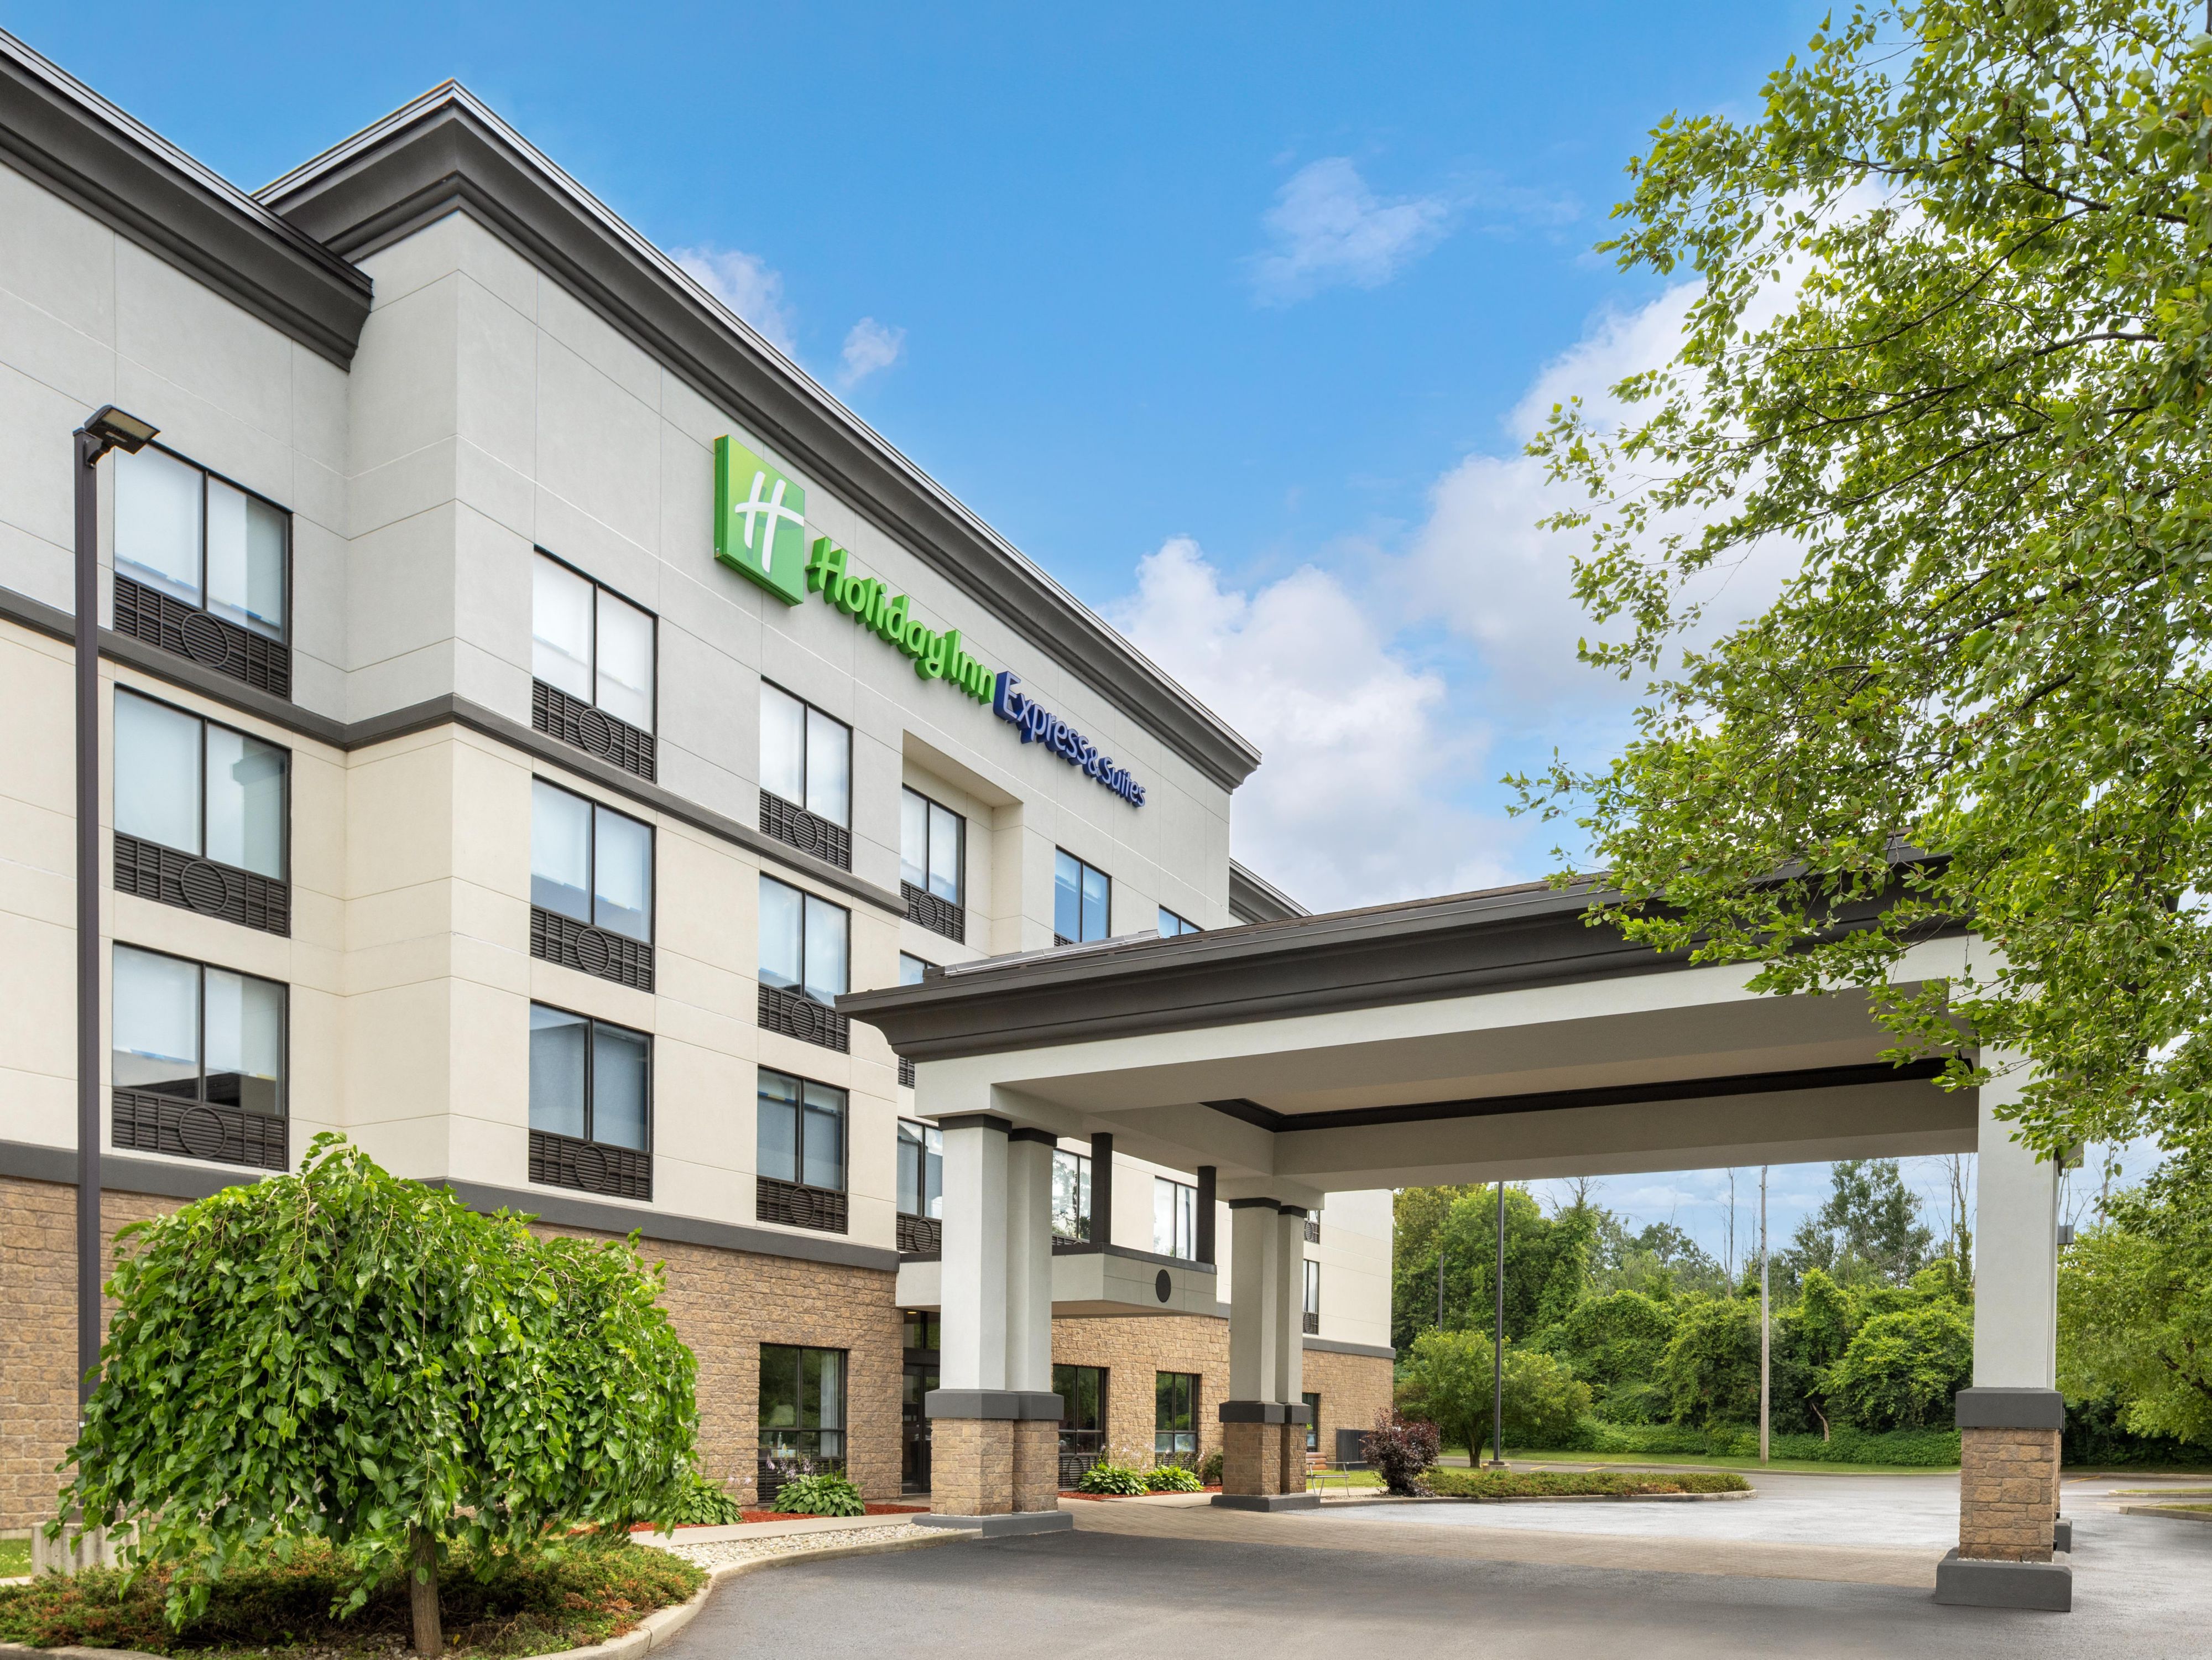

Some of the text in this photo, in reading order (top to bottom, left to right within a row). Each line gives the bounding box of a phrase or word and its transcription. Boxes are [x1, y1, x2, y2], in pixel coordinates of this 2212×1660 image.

[734, 470, 805, 574] H
[805, 536, 947, 680] Holiday
[942, 628, 996, 705] Inn
[993, 670, 1089, 766] Express
[1097, 757, 1146, 808] Suites
